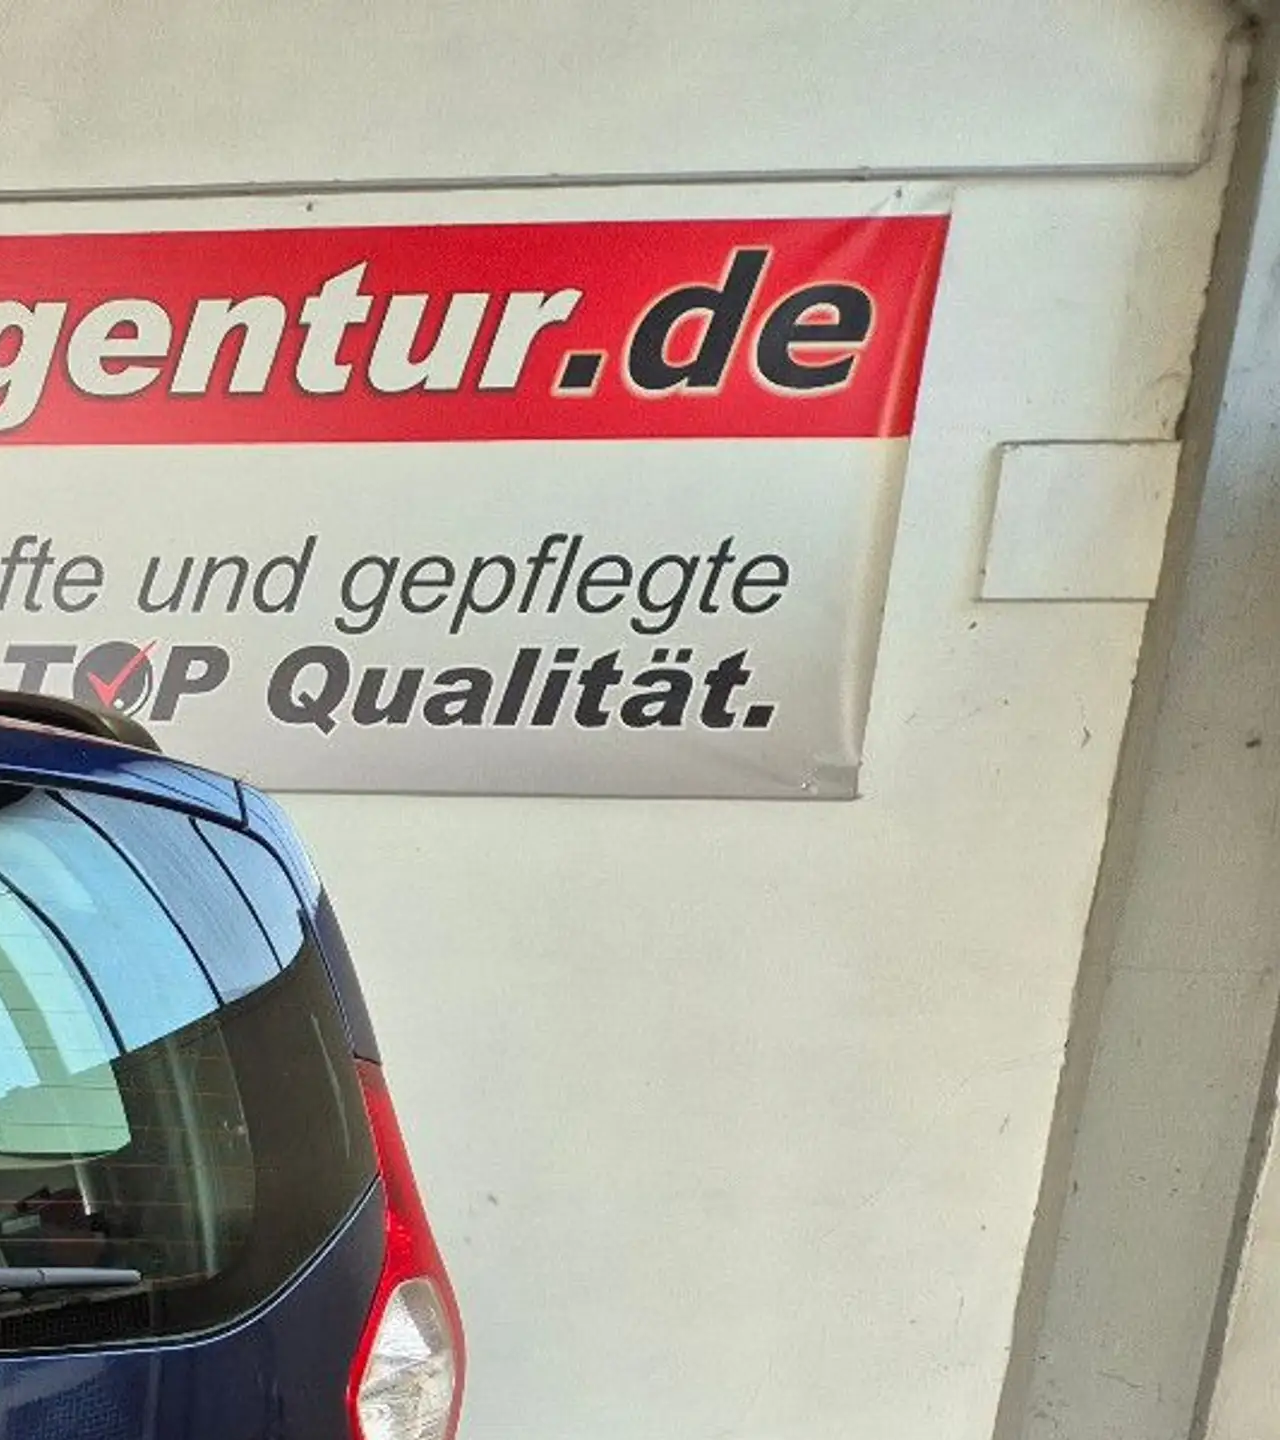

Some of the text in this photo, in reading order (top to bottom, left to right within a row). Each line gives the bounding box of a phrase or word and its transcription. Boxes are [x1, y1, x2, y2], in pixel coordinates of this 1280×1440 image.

[138, 535, 317, 613] und
[334, 535, 789, 634] gepflegte
[4, 640, 230, 721] TOP
[266, 647, 777, 735] Qualität.
